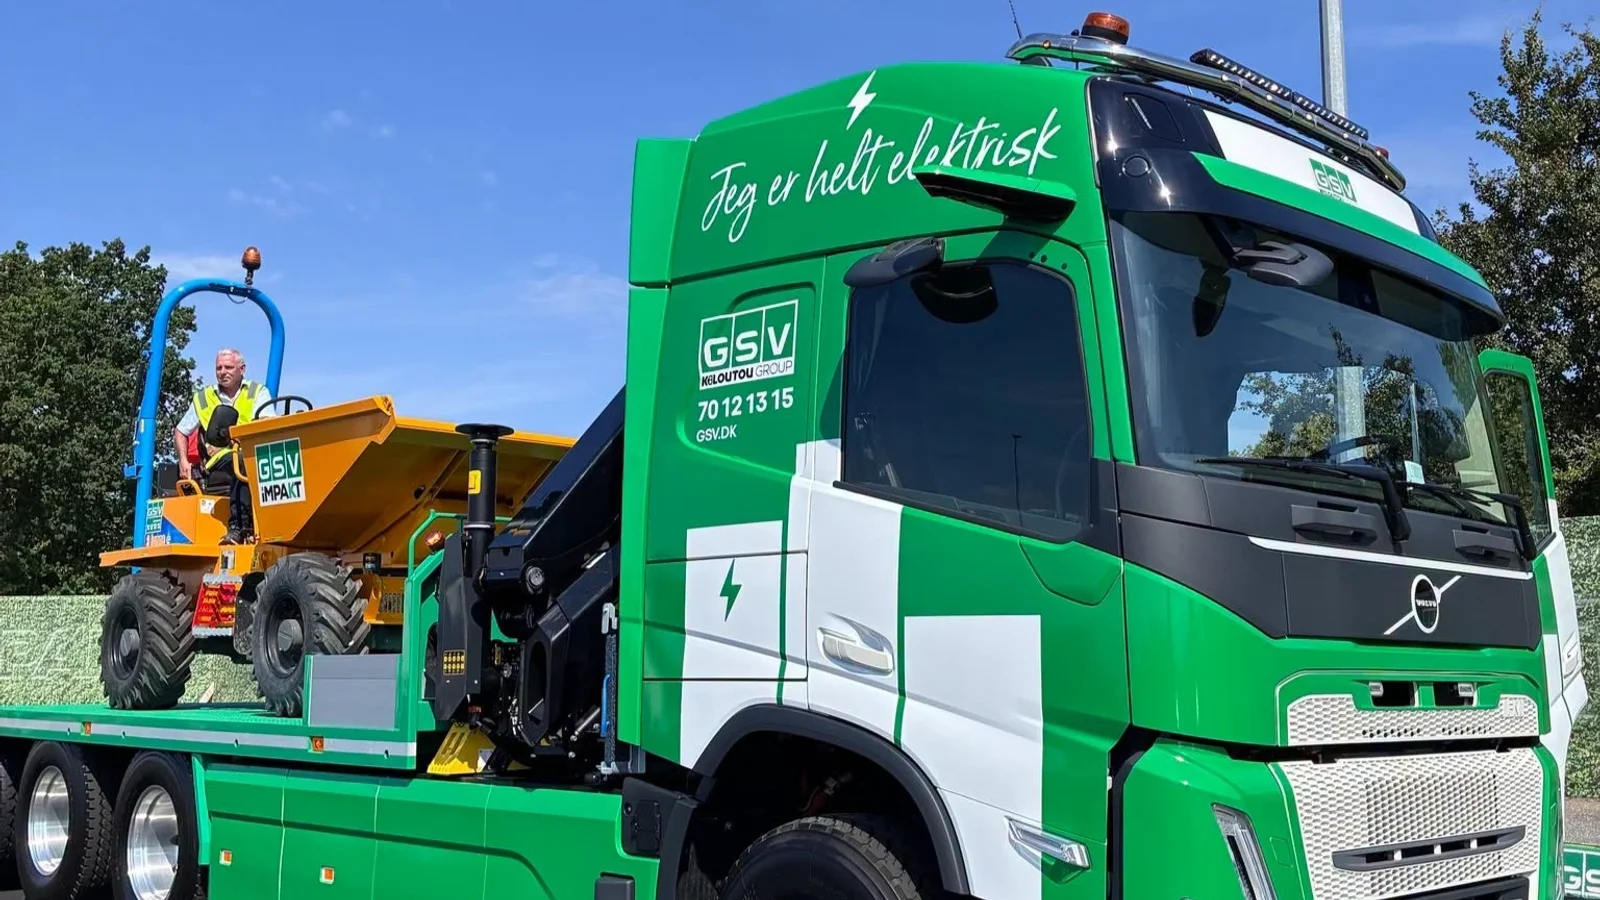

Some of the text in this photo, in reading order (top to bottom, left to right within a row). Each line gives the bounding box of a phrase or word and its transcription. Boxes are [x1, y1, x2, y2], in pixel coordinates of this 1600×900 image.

[701, 107, 1062, 242] Jeg er helt elektrisk
[1314, 168, 1354, 200] GSV
[703, 322, 792, 368] GSV
[755, 360, 793, 377] GROUP
[698, 386, 794, 422] 70 12 13 15
[696, 424, 738, 443] GSV.DK
[258, 452, 299, 480] GSV
[1416, 599, 1437, 607] VOLVO
